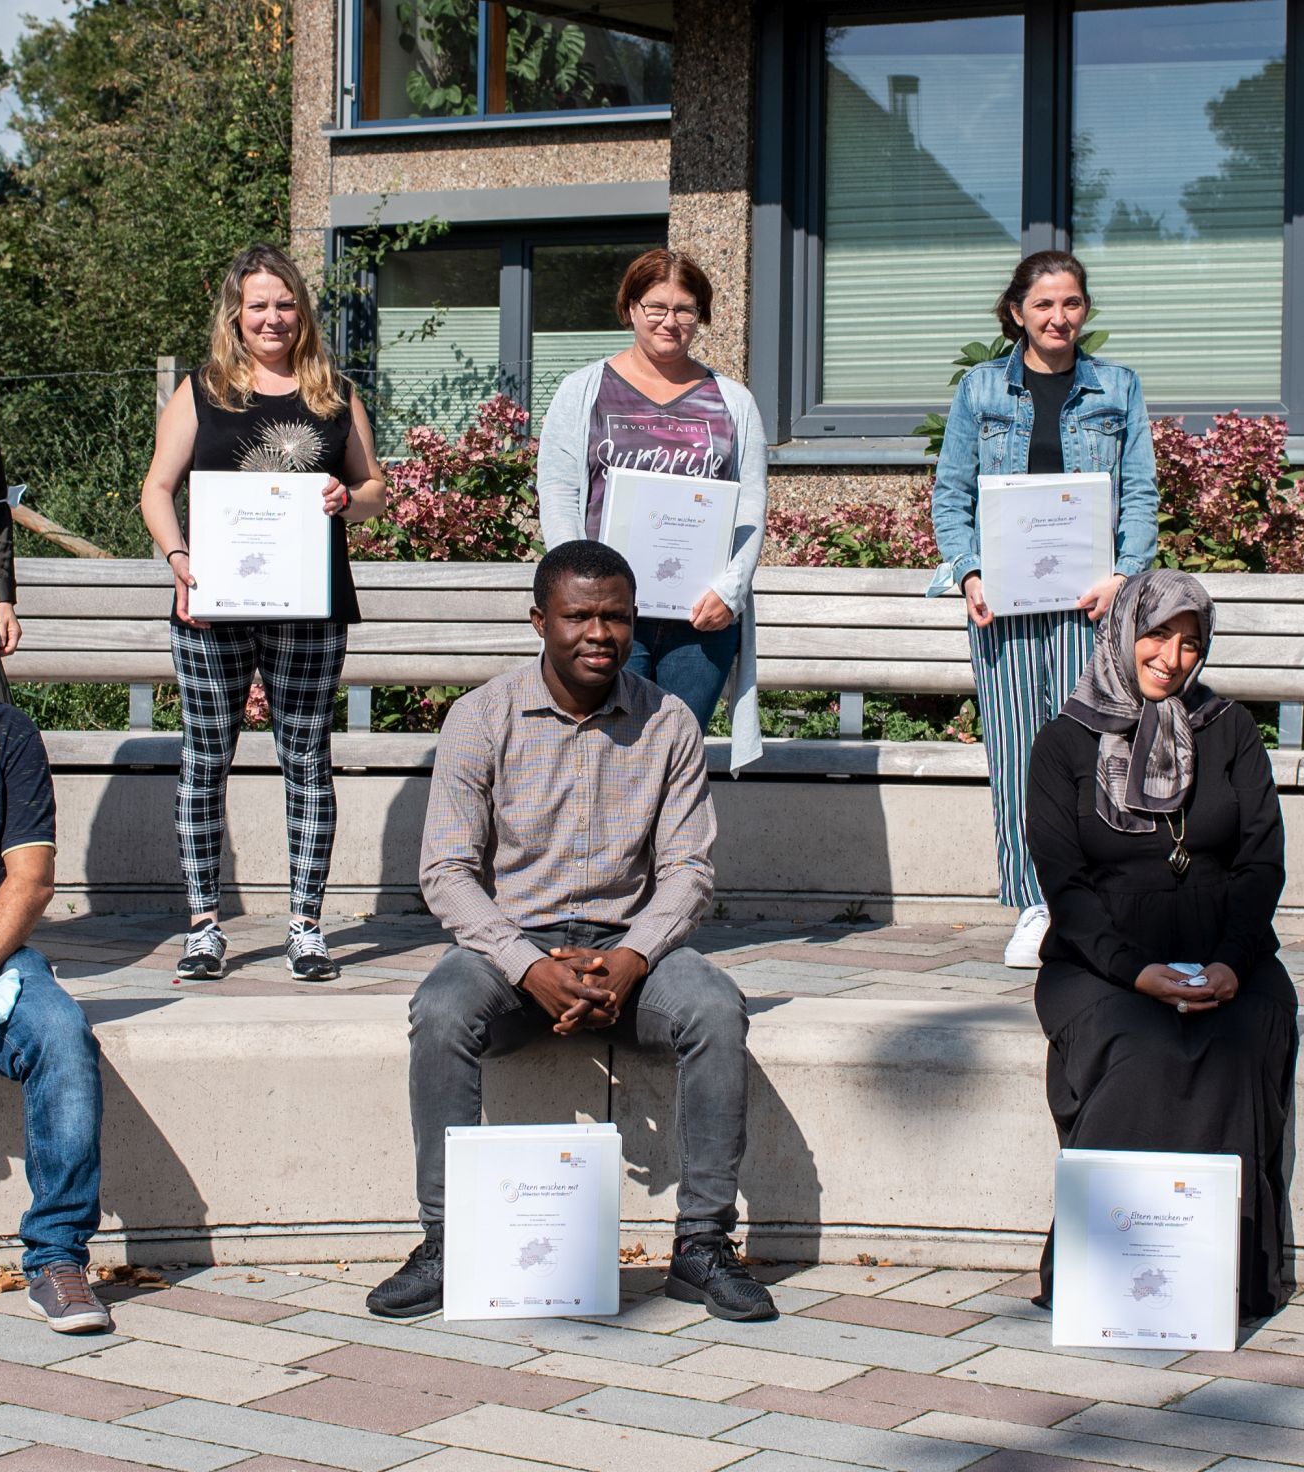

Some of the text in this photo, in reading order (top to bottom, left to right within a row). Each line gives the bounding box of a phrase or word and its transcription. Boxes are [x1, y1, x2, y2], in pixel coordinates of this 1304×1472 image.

[613, 423, 657, 431] savoir
[517, 1182, 538, 1191] Eltern
[539, 1181, 566, 1191] mischen
[1130, 1211, 1151, 1220] Eltern
[1153, 1212, 1181, 1221] mischen
